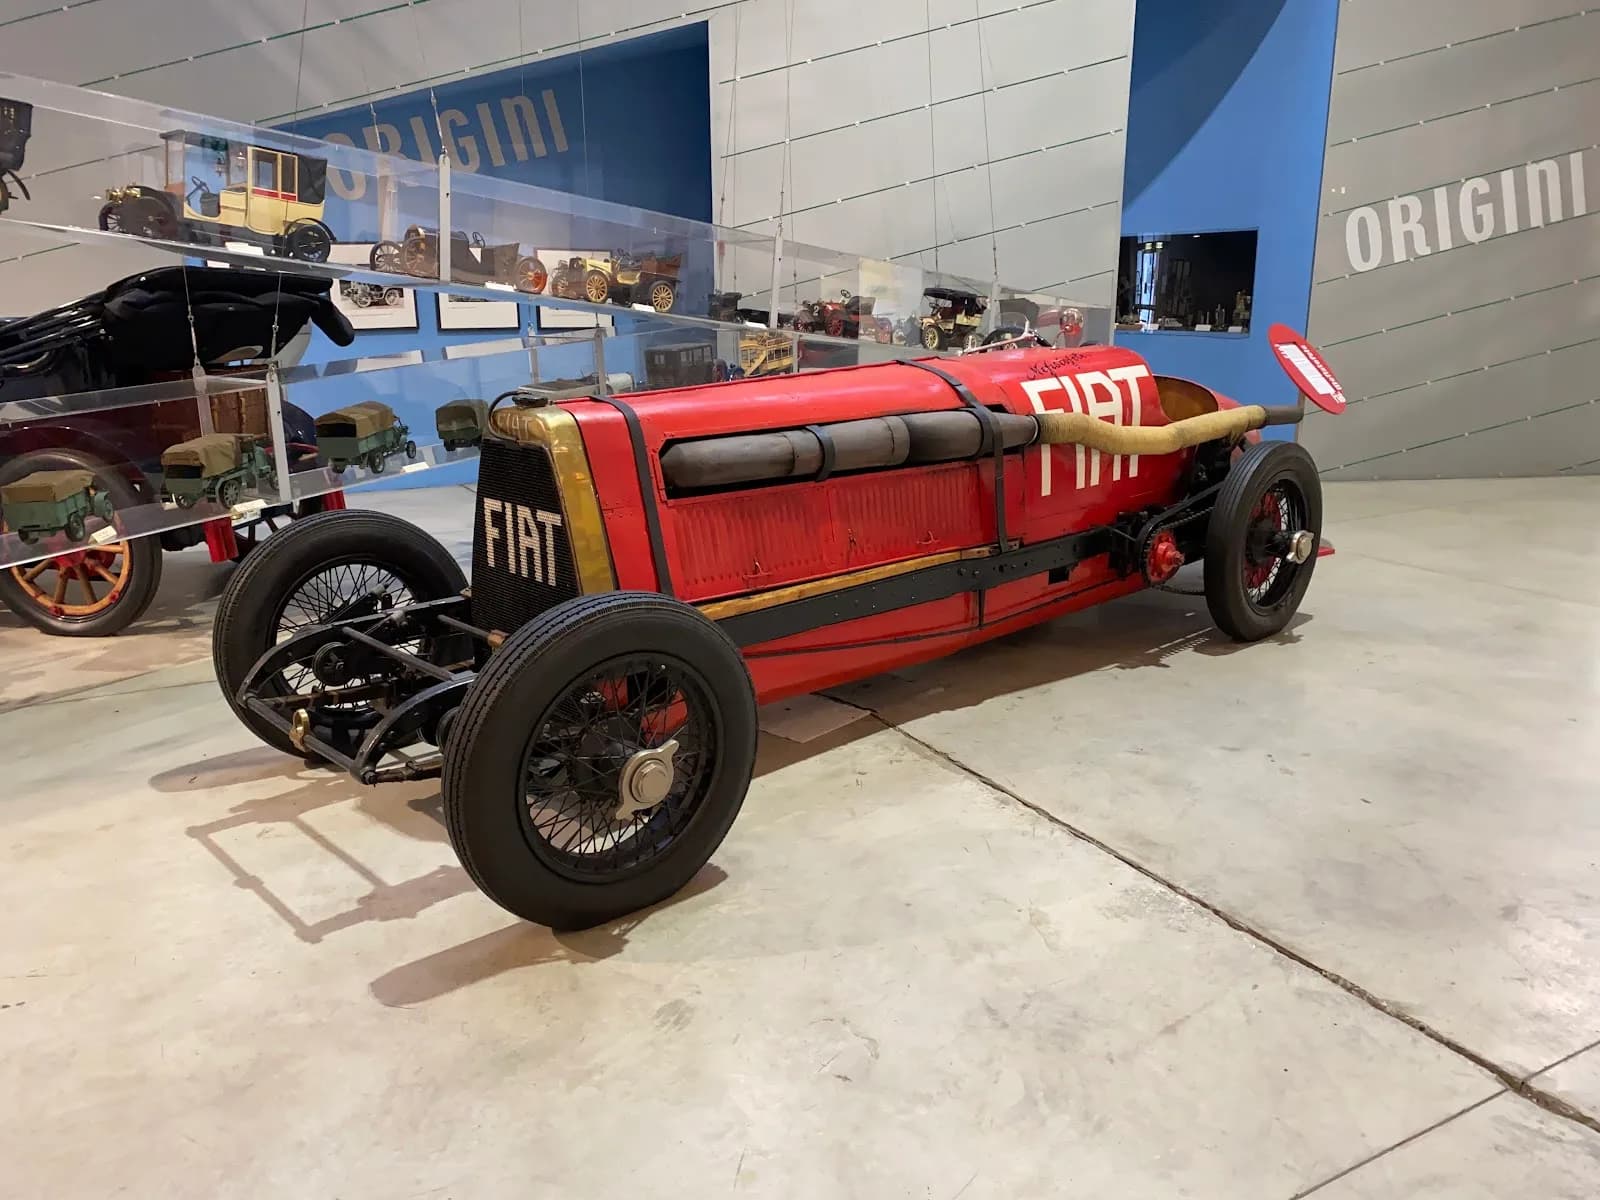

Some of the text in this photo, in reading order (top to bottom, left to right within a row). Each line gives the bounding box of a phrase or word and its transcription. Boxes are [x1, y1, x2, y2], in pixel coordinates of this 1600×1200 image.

[1346, 152, 1586, 272] ORIGINI
[813, 305, 820, 317] 2
[497, 412, 533, 440] FIAT
[1020, 364, 1149, 497] FIAT
[484, 497, 563, 587] FIAT
